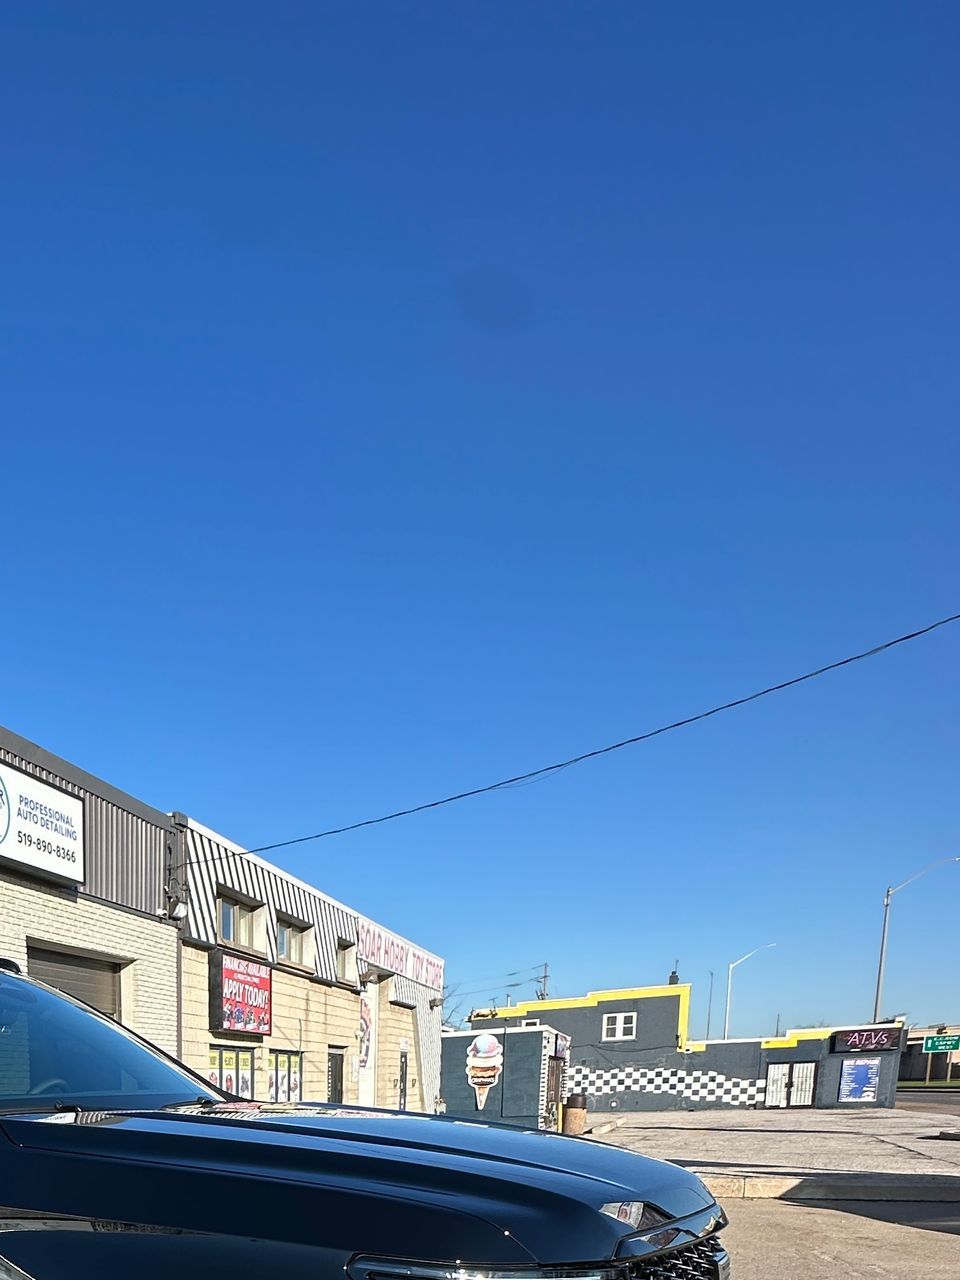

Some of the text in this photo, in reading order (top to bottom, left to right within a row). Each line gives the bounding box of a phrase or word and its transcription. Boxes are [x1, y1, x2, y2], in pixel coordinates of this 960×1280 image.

[16, 807, 78, 842] AUTO DETAILING
[18, 794, 74, 828] PROFESSIONAL
[17, 830, 77, 864] 519-890-8366
[358, 923, 382, 964] SOAR
[384, 936, 410, 975] HOBBY
[412, 949, 425, 981] TOY
[223, 977, 244, 1002] APPLY
[245, 984, 269, 1011] TODAY!
[846, 1031, 889, 1047] ATVs
